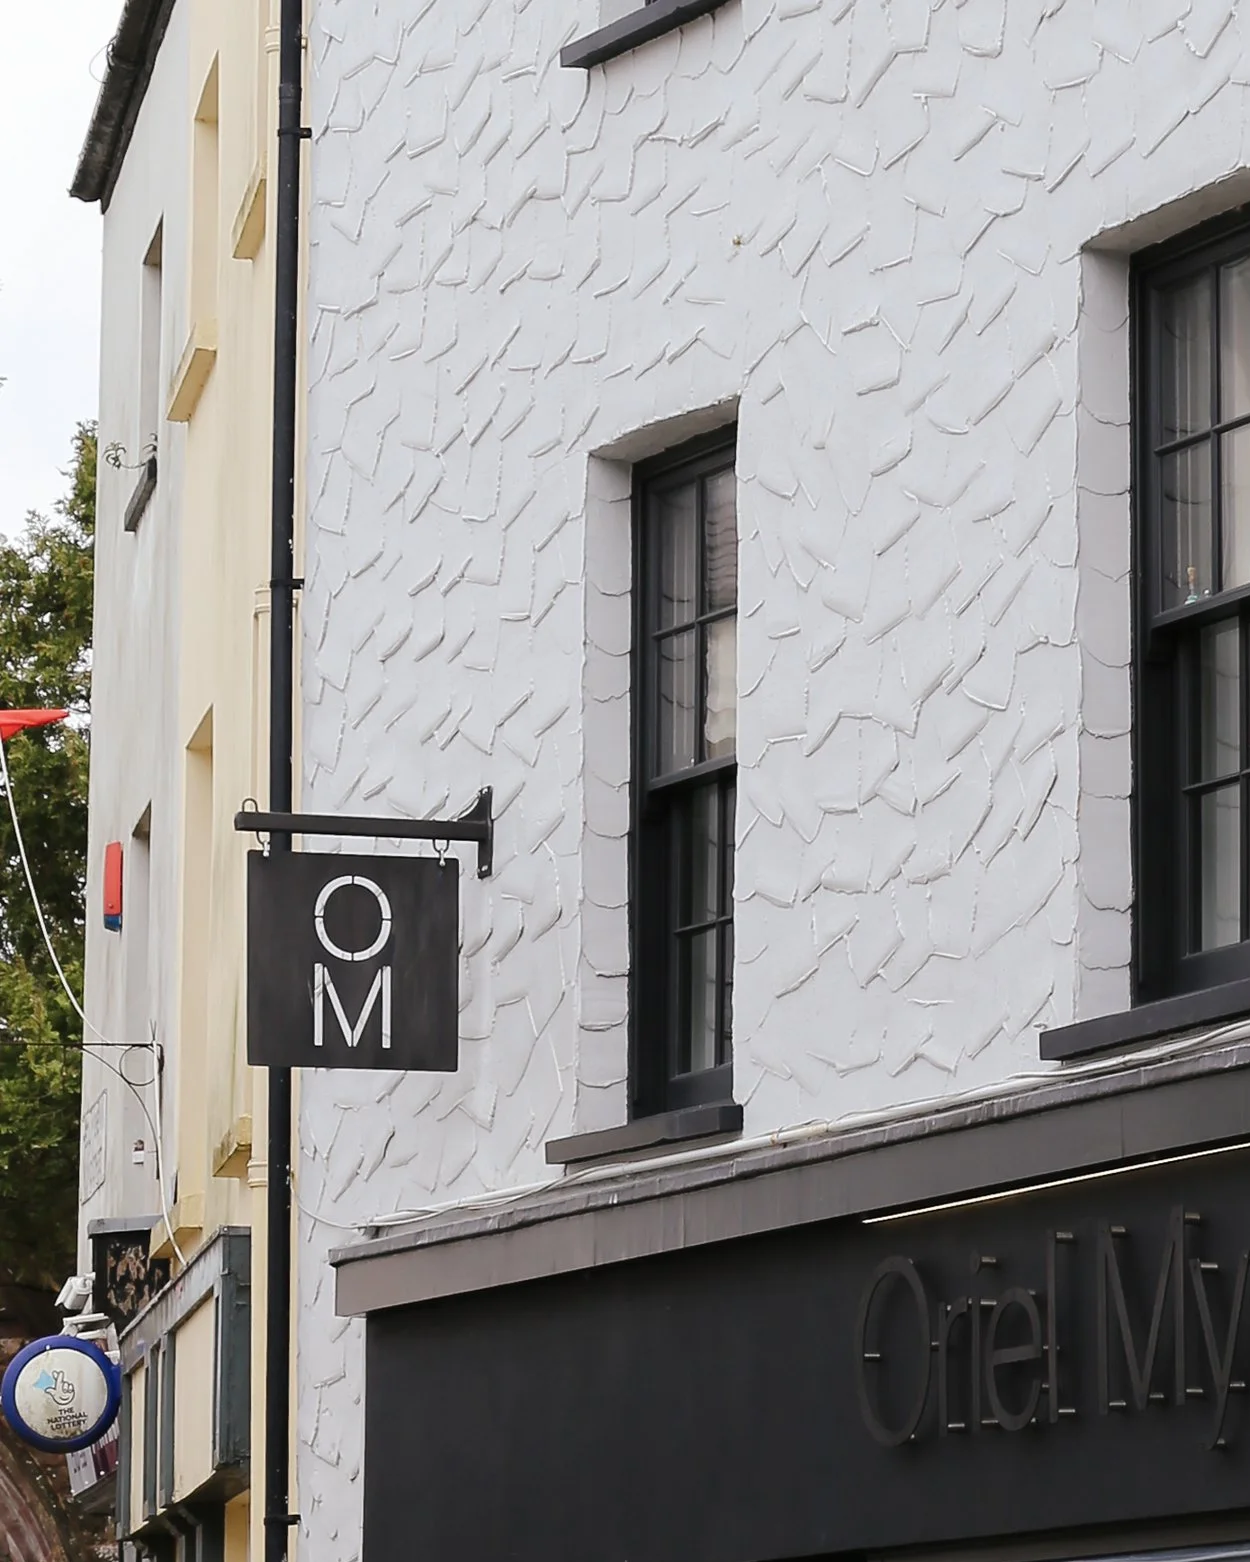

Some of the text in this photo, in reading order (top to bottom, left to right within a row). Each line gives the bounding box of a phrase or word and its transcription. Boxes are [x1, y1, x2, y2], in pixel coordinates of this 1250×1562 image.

[855, 1228, 1058, 1448] Oriel
[58, 1407, 75, 1416] THE
[47, 1412, 88, 1425] NATIONAL
[51, 1419, 87, 1431] LOTTERY
